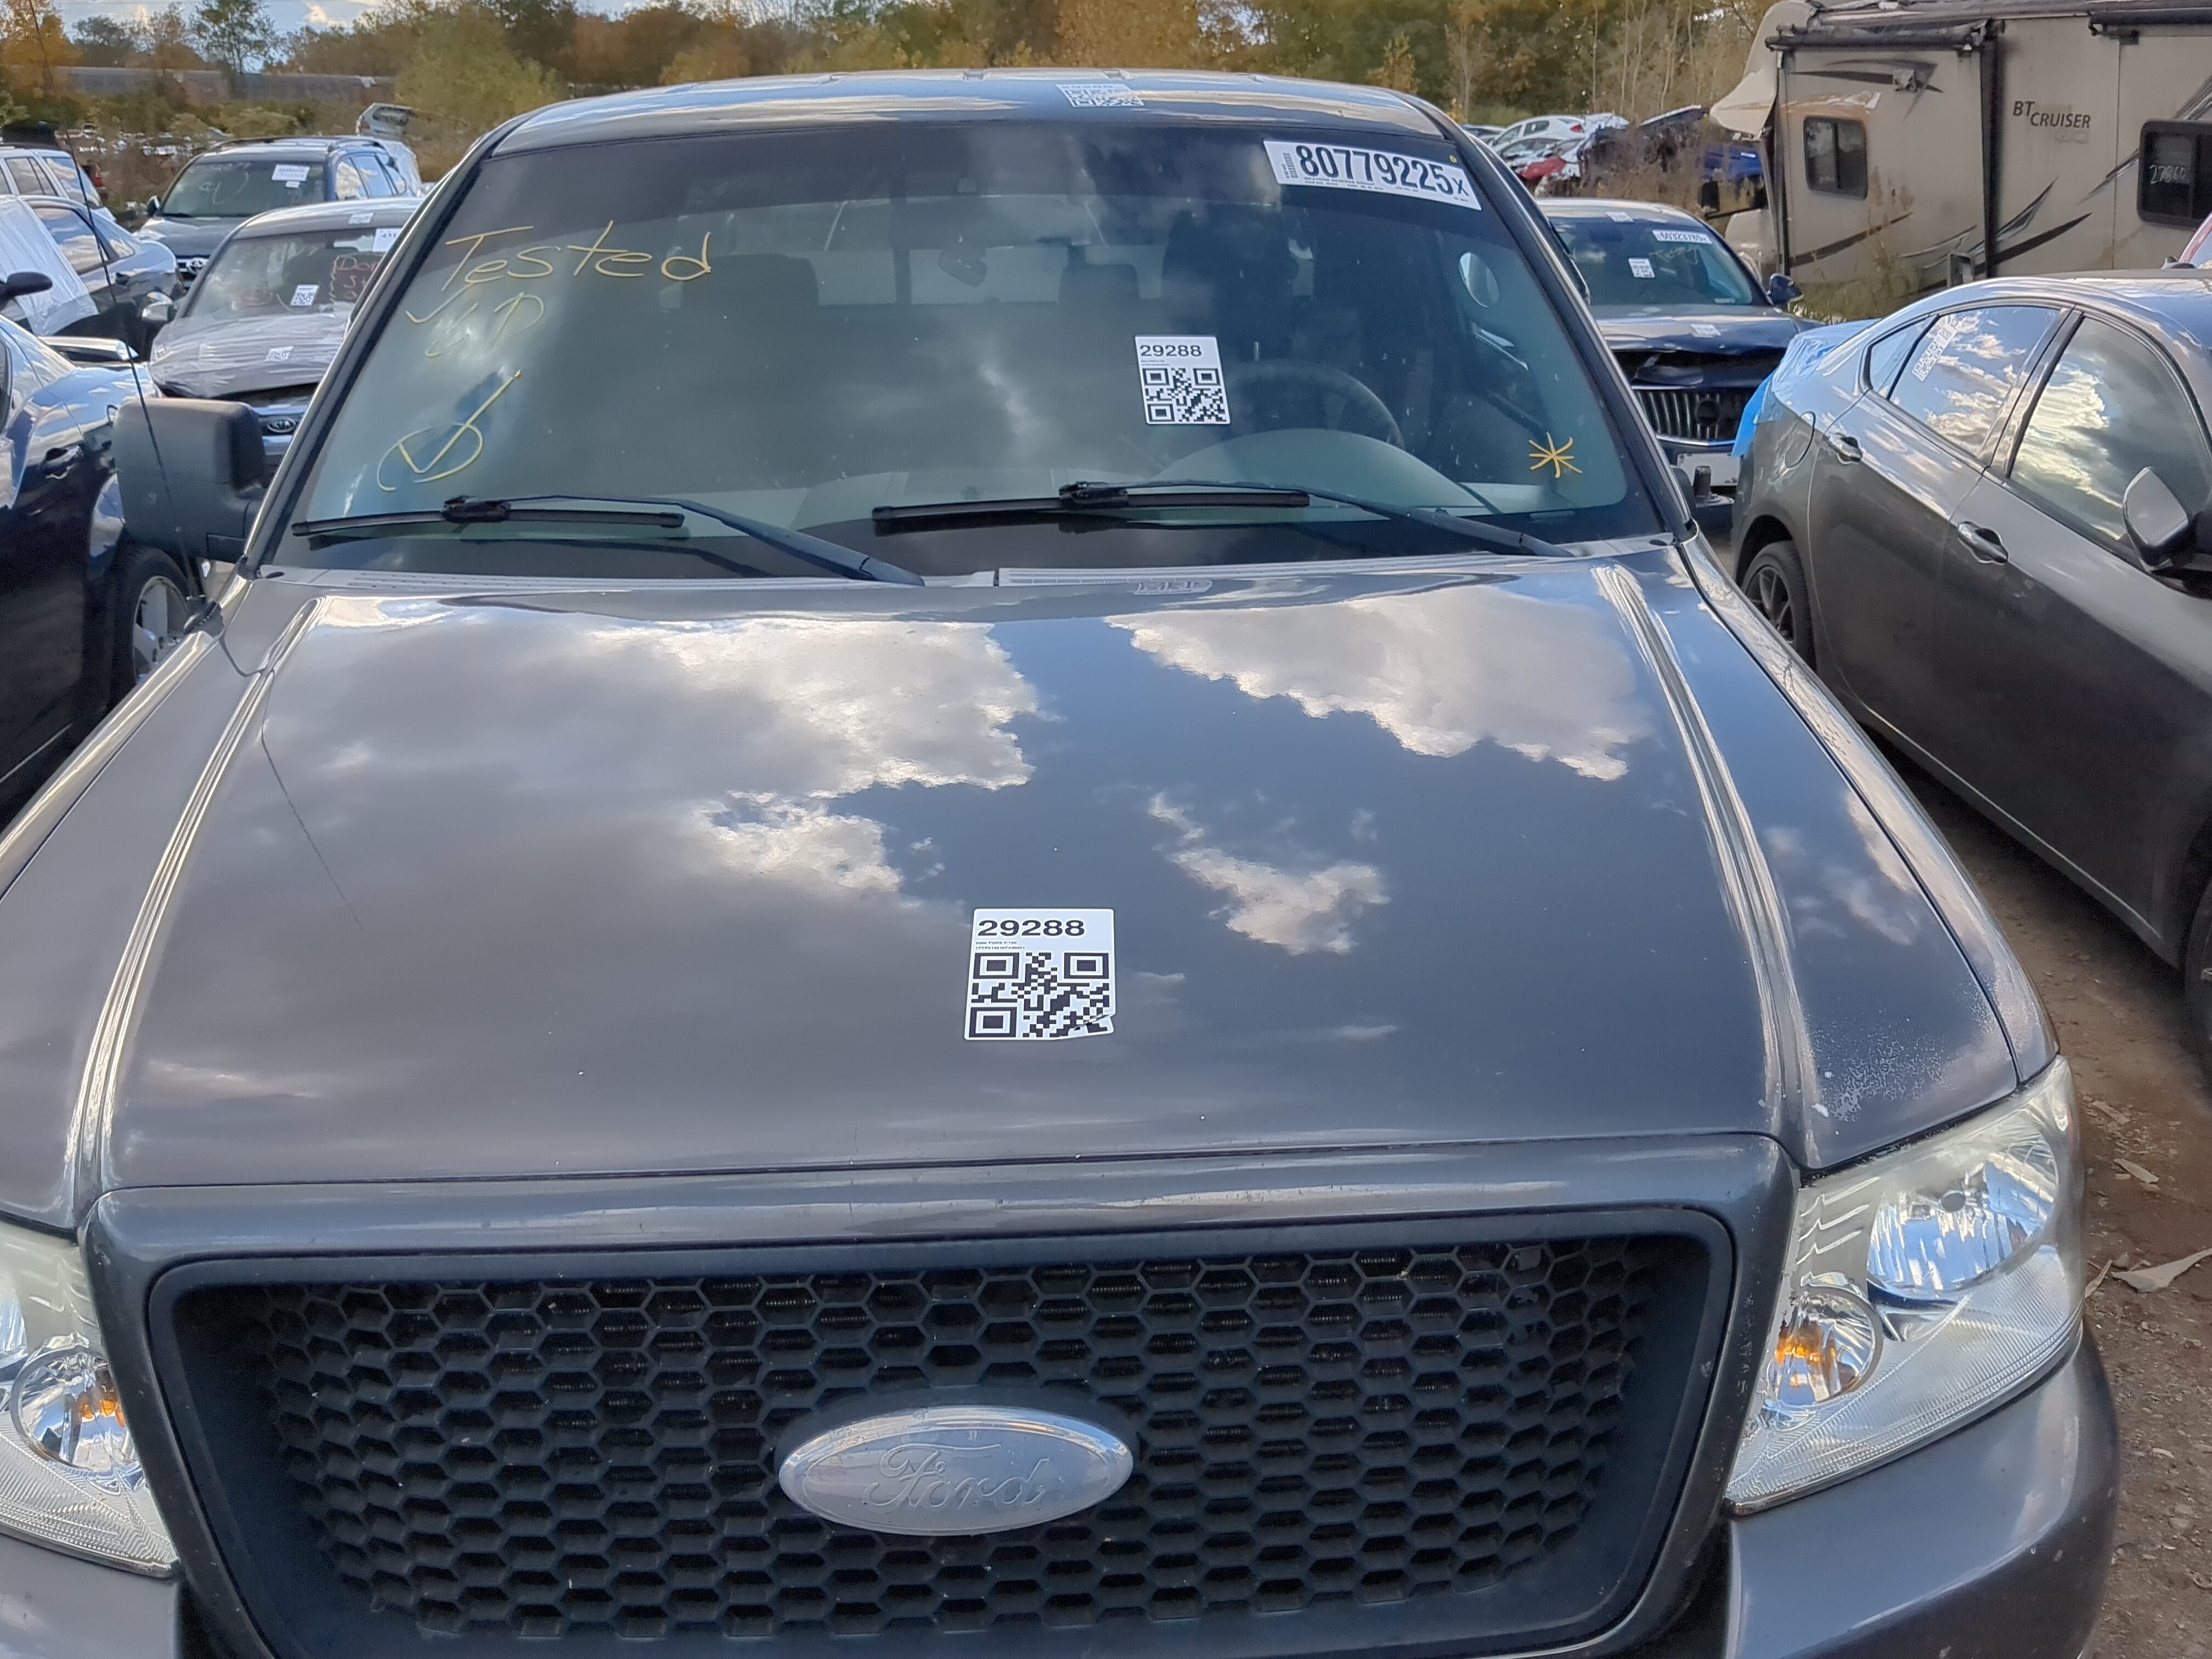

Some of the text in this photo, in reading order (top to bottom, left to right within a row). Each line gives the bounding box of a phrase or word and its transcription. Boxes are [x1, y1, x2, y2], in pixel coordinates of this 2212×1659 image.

[2013, 101, 2091, 128] BT CRUISER
[441, 220, 712, 291] Tested
[1140, 345, 1202, 357] 29288
[978, 919, 1085, 936] 29288
[863, 1443, 1049, 1513] Ford
